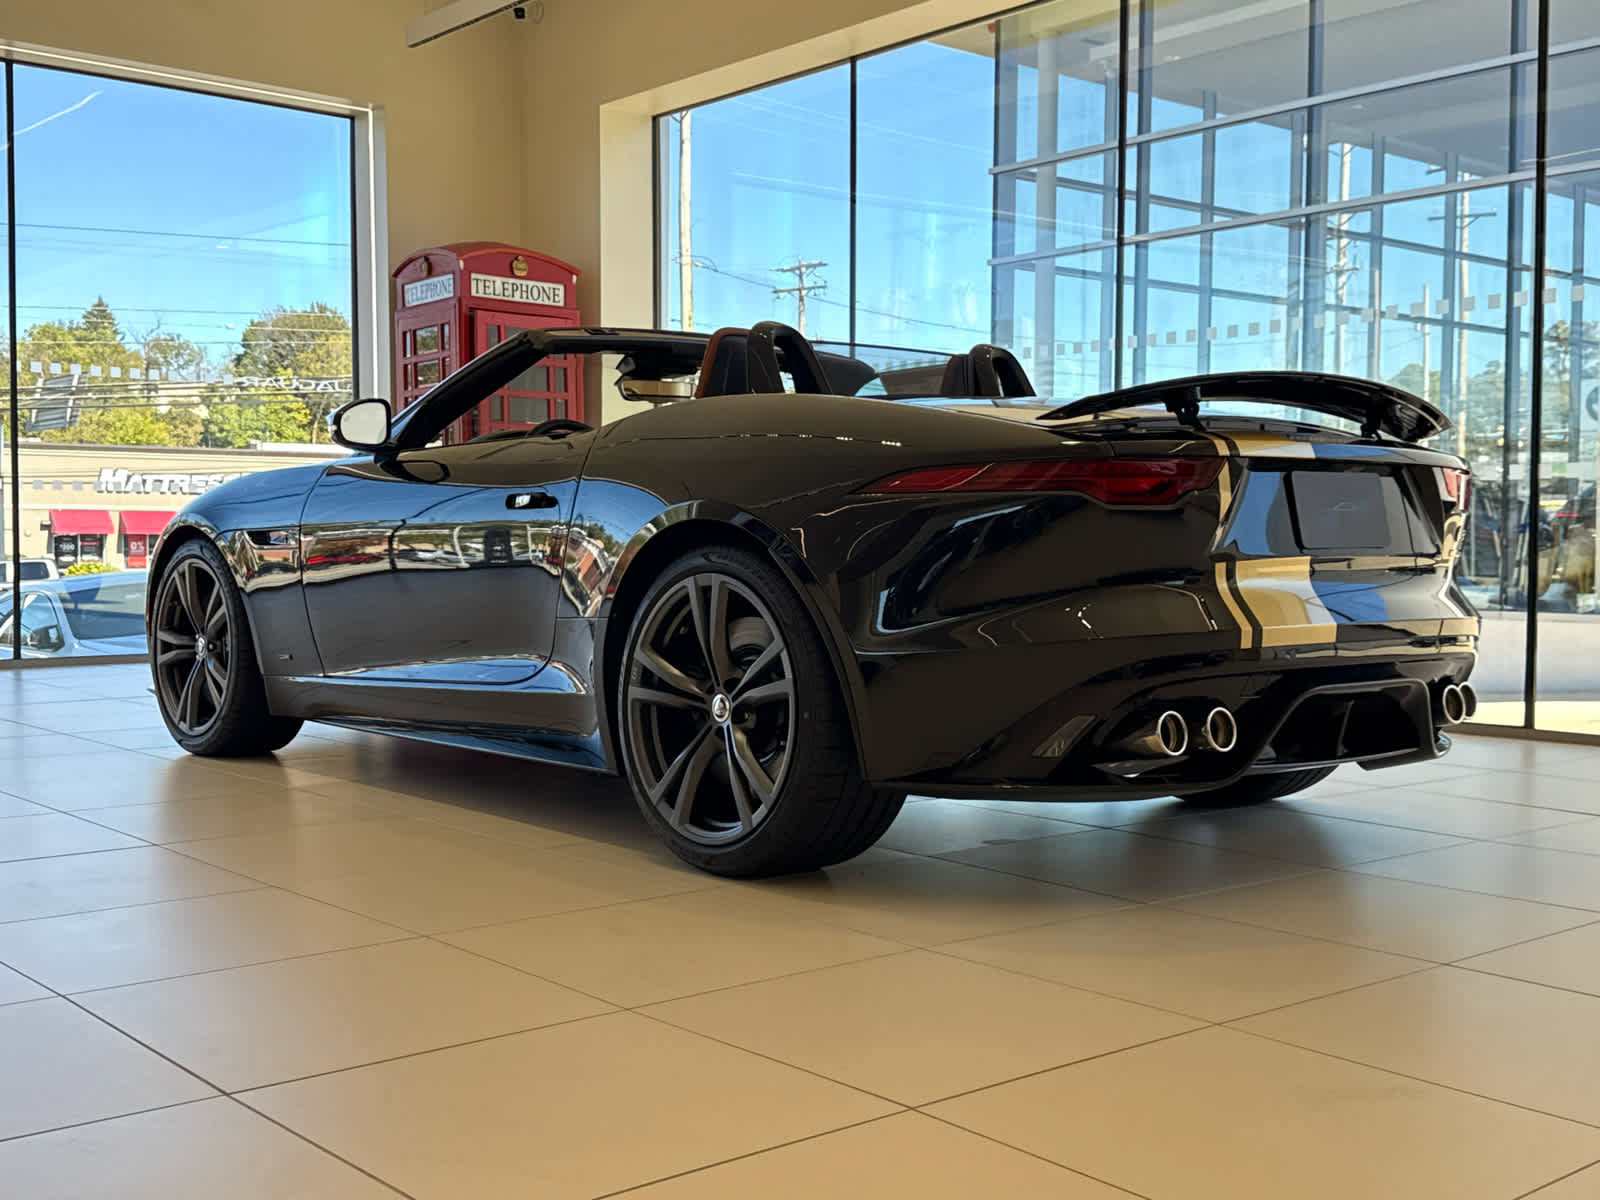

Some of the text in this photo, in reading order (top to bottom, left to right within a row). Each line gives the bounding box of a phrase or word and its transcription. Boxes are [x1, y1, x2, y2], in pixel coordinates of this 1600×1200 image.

[406, 277, 453, 305] TELEPHONE
[472, 277, 561, 304] TELEPHONE
[97, 467, 241, 494] MATTRES
